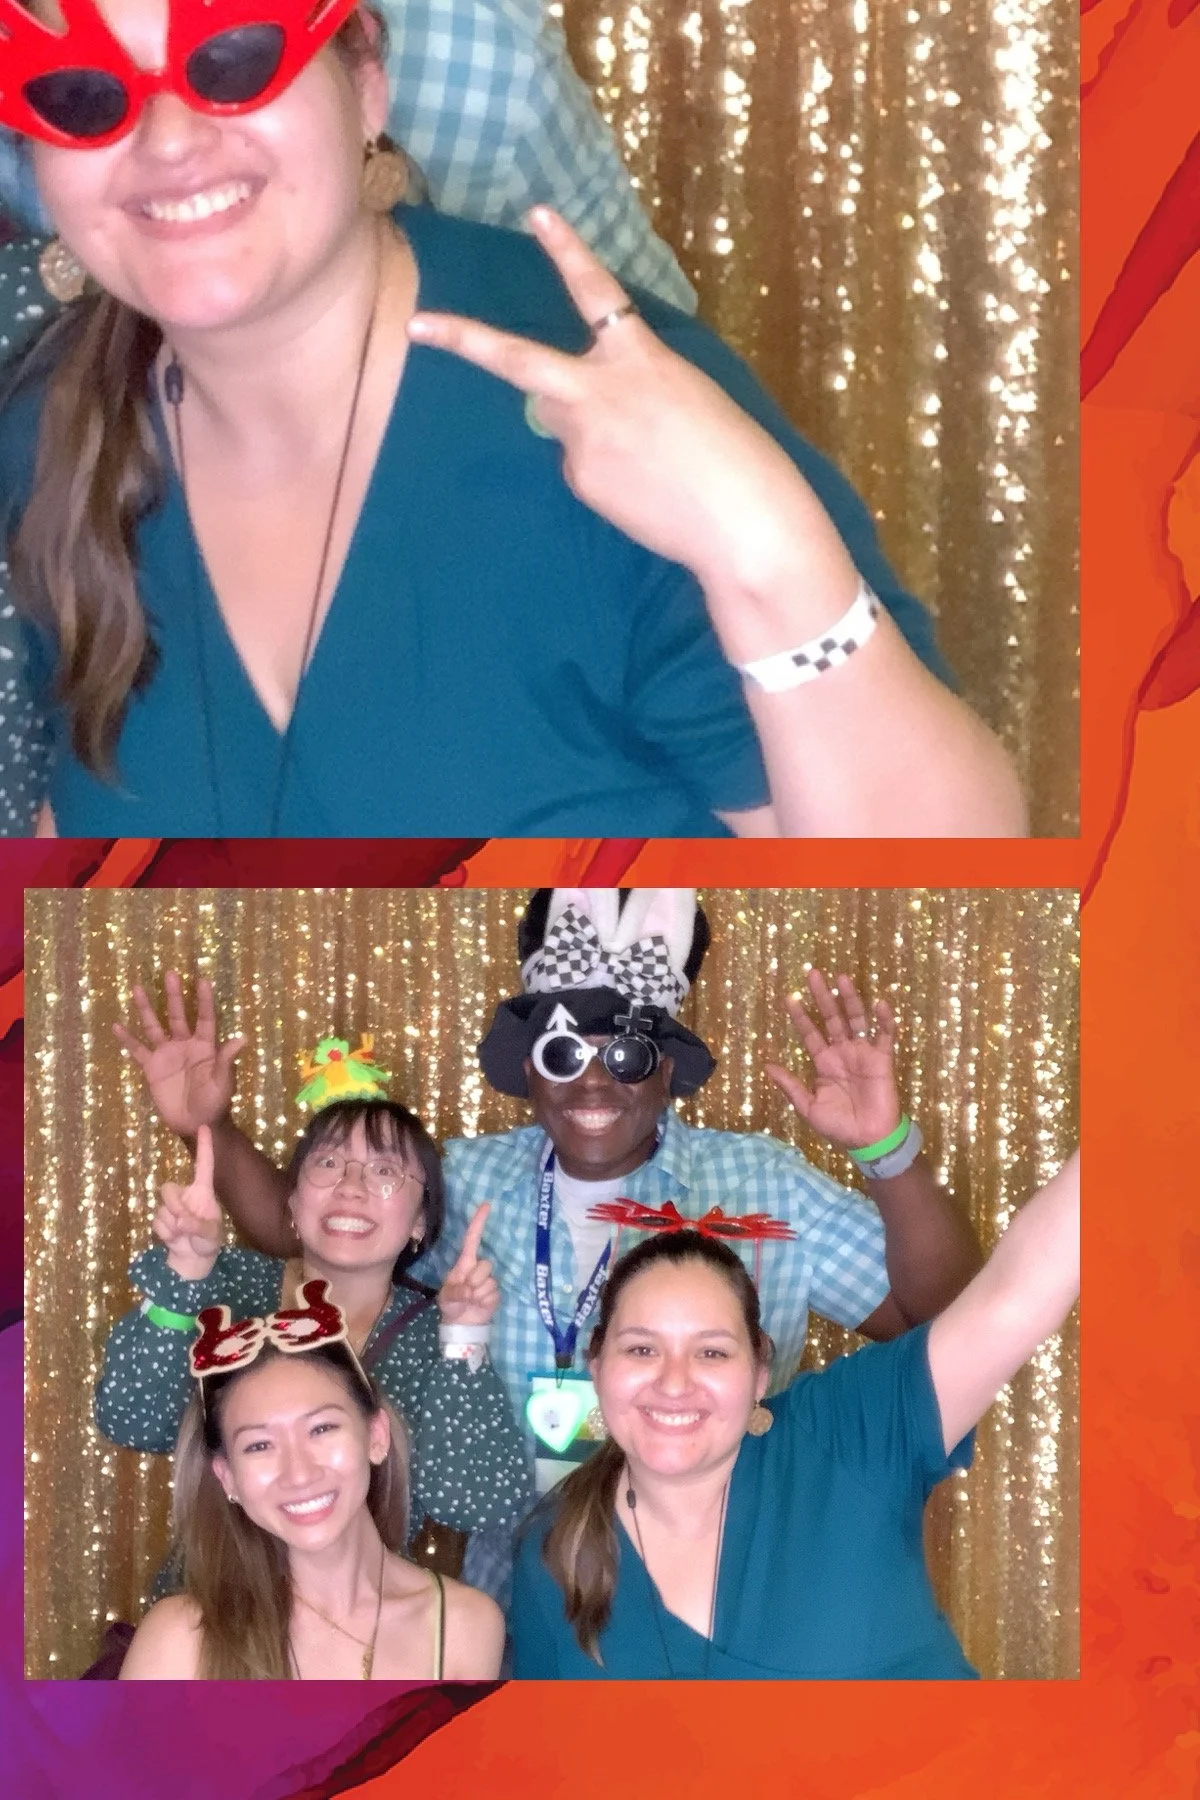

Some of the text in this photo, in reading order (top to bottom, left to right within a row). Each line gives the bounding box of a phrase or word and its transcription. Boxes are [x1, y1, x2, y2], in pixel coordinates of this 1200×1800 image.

[538, 1171, 554, 1231] Baxter
[536, 1263, 555, 1327] Baxter
[575, 1264, 610, 1329] Baxter
